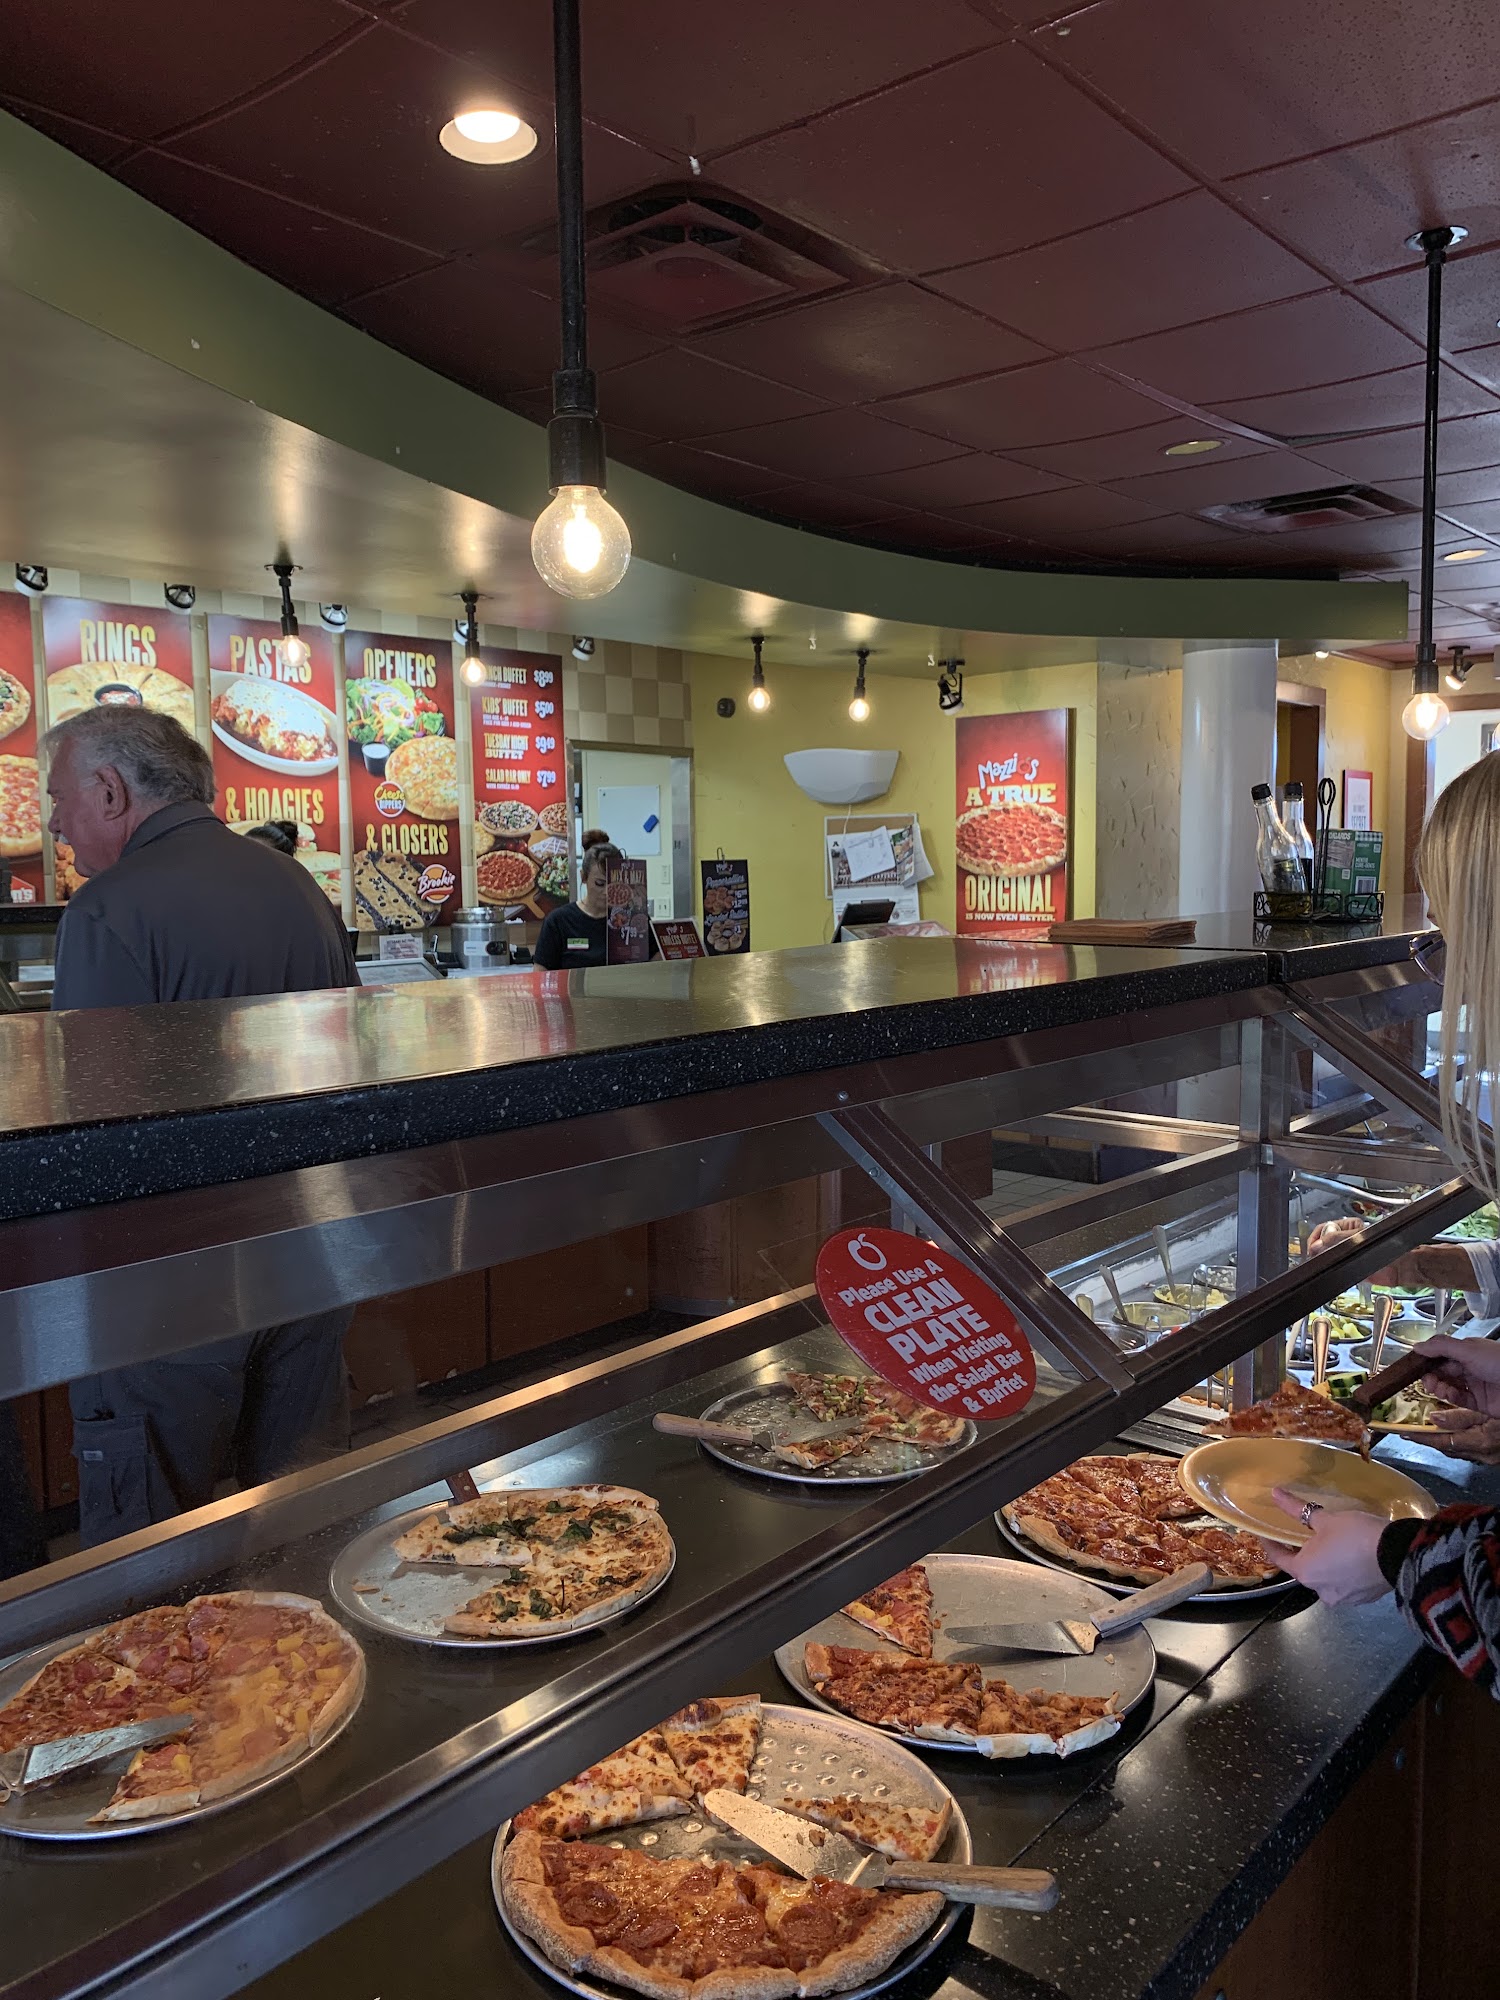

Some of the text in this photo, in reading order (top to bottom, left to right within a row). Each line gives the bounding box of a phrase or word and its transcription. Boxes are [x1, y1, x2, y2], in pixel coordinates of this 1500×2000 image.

[79, 618, 157, 668] RINGS
[363, 647, 436, 688] OPENERS
[503, 666, 527, 684] BUFFET
[502, 697, 528, 717] BUFFET
[484, 732, 510, 749] TUESDAY
[485, 748, 524, 760] BUFFET
[485, 767, 505, 784] SALAD
[226, 787, 324, 825] & HOAGIES
[373, 786, 405, 801] Cheese
[379, 800, 402, 810] DIPPERS
[965, 783, 1056, 807] A TRUE
[366, 823, 449, 856] & CLOSERS
[417, 869, 456, 894] Brookie
[964, 874, 1056, 913] ORIGINAL
[965, 913, 974, 921] IS
[975, 913, 994, 921] NOW
[995, 913, 1018, 922] EVEN
[837, 1258, 944, 1307] Please Use A
[863, 1276, 965, 1333] CLEAN
[886, 1303, 991, 1364] PLATE
[908, 1332, 1012, 1384] When Visiting
[928, 1349, 1024, 1402] the Salad Bar
[961, 1372, 1028, 1414] & Buffet
